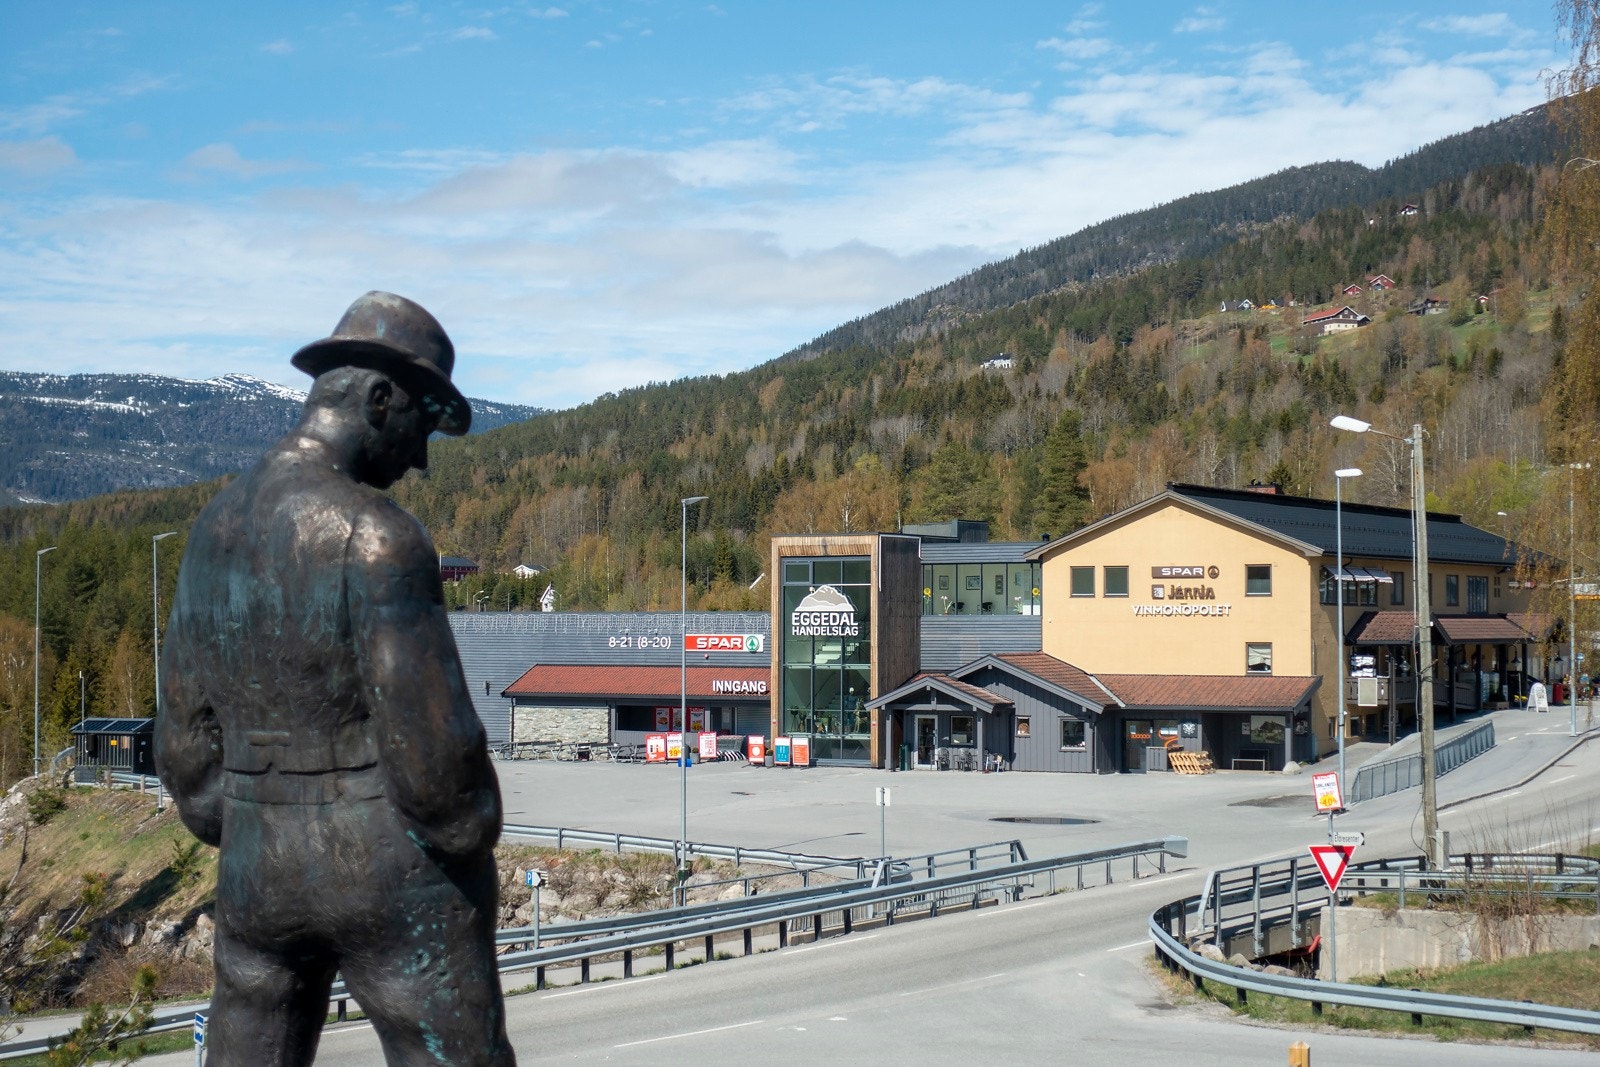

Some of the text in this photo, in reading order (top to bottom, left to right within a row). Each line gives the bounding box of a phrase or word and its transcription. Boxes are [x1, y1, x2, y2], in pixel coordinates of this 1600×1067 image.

[1161, 567, 1204, 576] SPAR
[1132, 604, 1232, 616] VINMONOPOLET
[791, 612, 859, 626] EGGEDAL
[791, 626, 859, 636] HANDELSLAG
[608, 636, 672, 650] 8-21 (8-20)
[696, 637, 743, 649] SPAR
[712, 679, 767, 693] INNGANG
